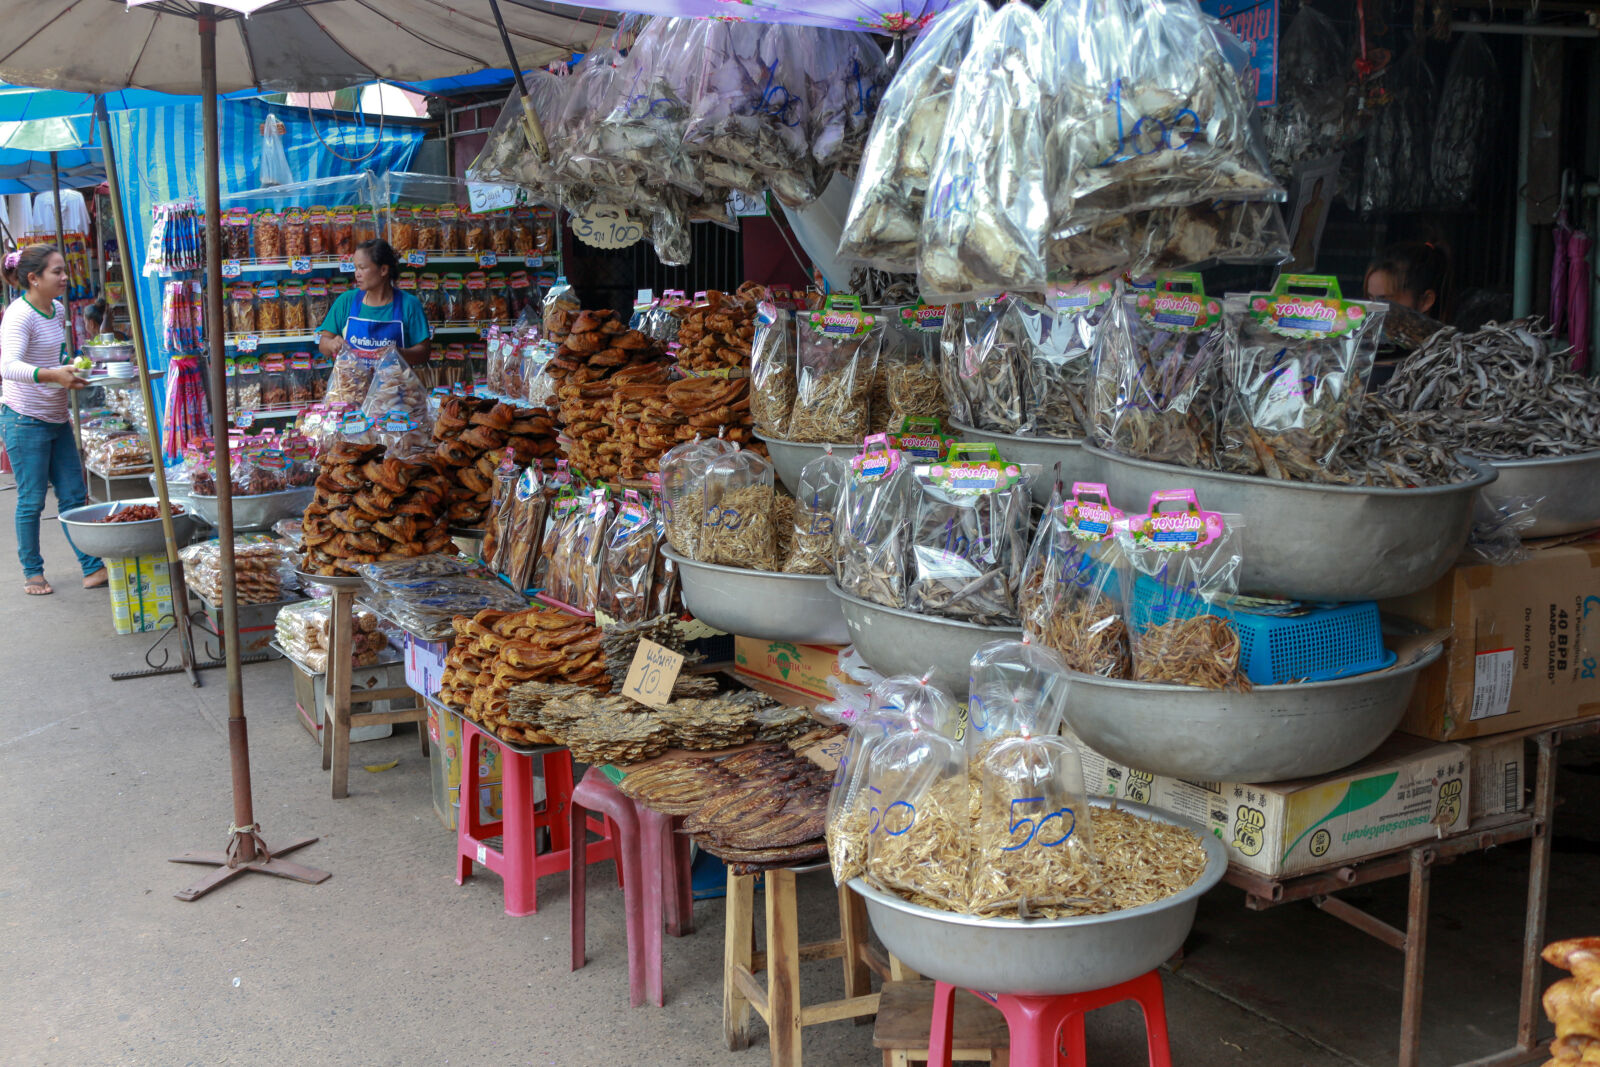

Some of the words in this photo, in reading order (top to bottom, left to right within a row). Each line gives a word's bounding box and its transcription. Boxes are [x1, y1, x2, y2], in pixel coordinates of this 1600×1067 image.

[1096, 77, 1200, 167] 100
[576, 218, 594, 237] 3
[609, 223, 640, 244] 100
[1155, 296, 1201, 313] ของฝาก
[1274, 302, 1337, 319] ของฝาก
[823, 313, 858, 326] ของฝาก
[902, 436, 940, 448] ของฝาก
[950, 463, 998, 479] ของฝาก
[1078, 504, 1111, 522] ของฝาก
[1151, 513, 1201, 530] ของฝาก
[1523, 607, 1532, 622] Do
[1557, 608, 1569, 630] 40
[1523, 624, 1532, 643] Not
[1522, 645, 1531, 670] Drop
[1557, 633, 1568, 671] BPB
[633, 663, 661, 695] 10
[1000, 797, 1076, 851] 50
